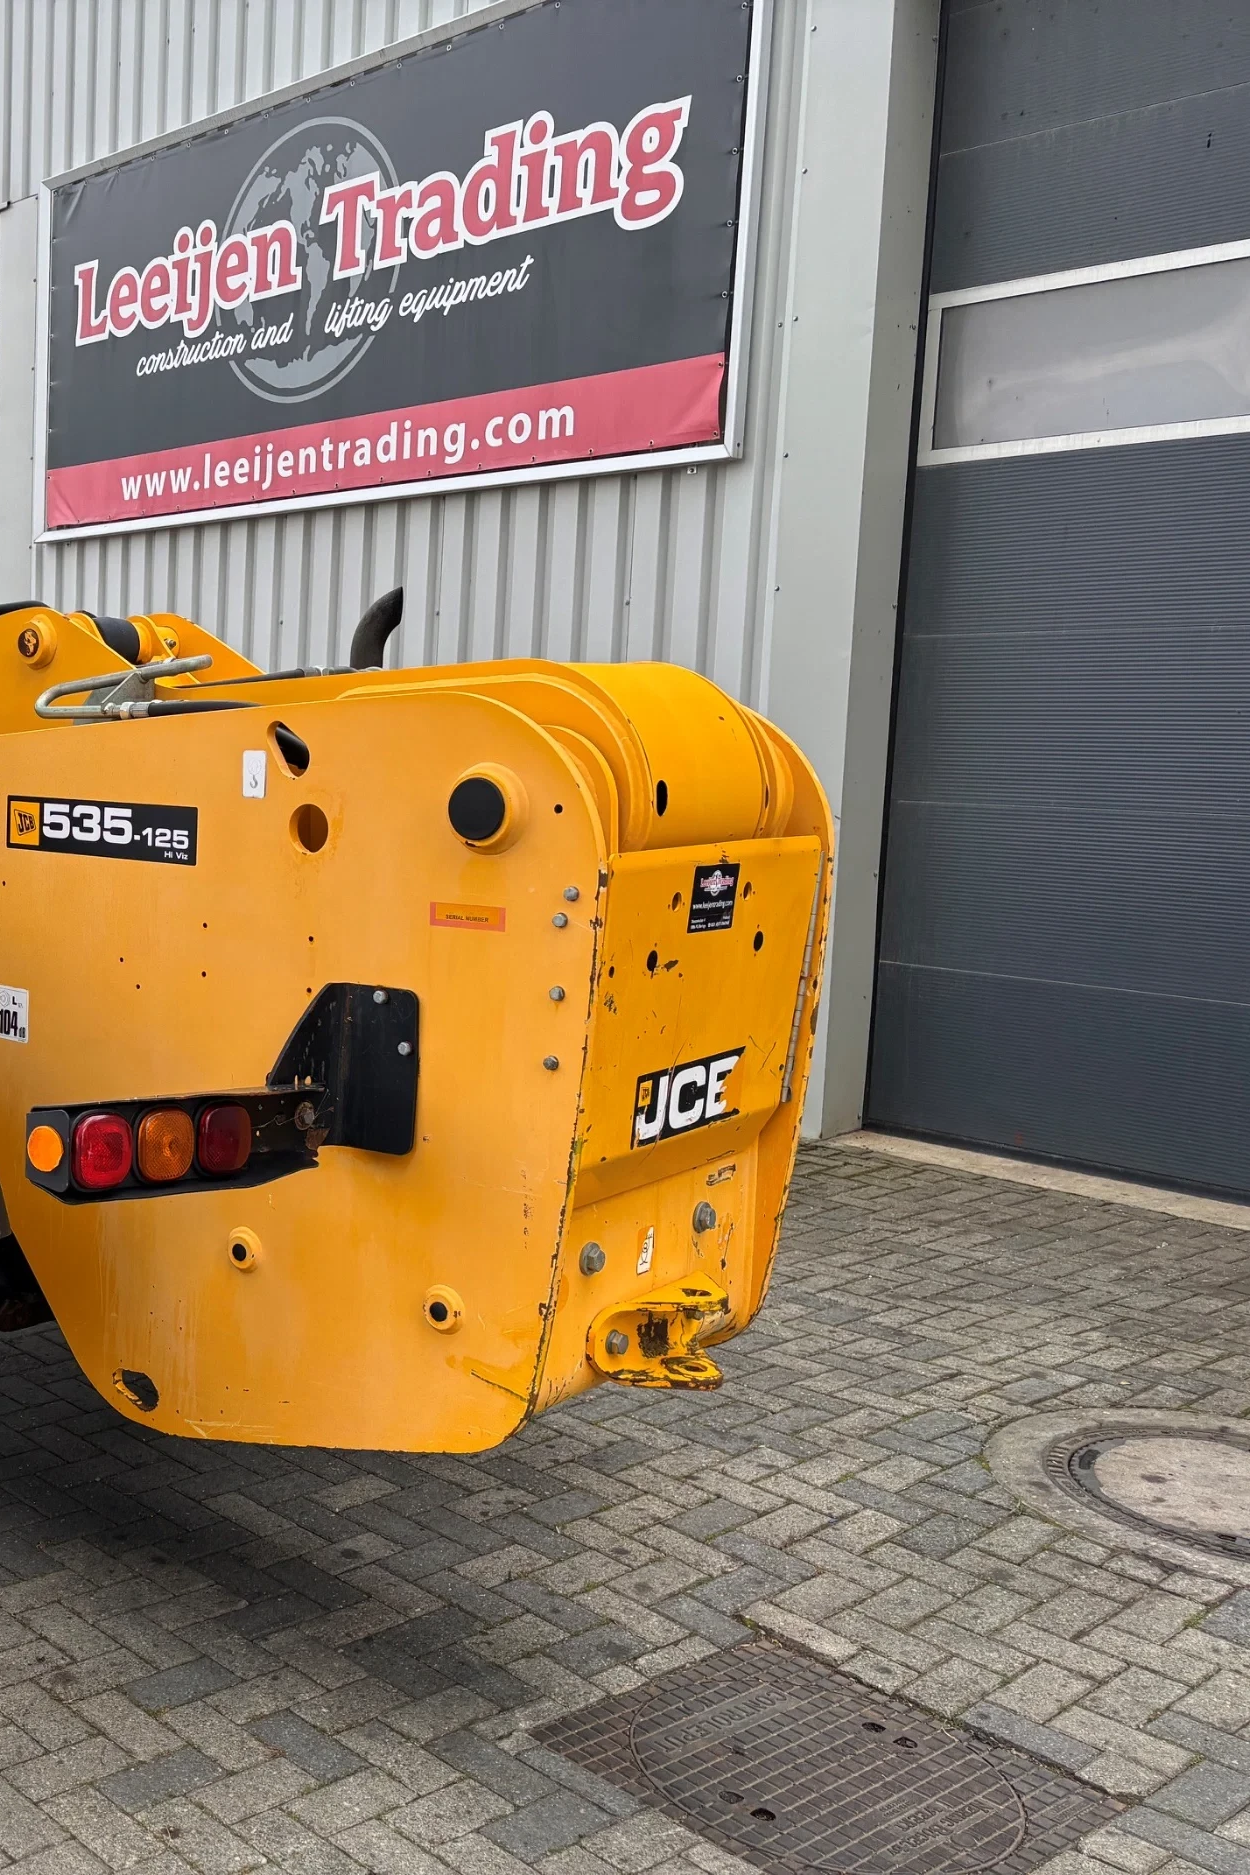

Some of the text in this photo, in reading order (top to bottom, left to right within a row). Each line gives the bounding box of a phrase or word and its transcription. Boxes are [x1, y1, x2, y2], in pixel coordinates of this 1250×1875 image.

[75, 95, 693, 346] Leeijen Trading
[324, 254, 536, 333] lifting equipment
[136, 313, 294, 377] construction and
[121, 402, 576, 501] www.leeijentrading.com
[17, 812, 36, 834] JCB
[164, 850, 189, 860] Hi Viz
[465, 915, 489, 923] NUMBER
[0, 1008, 19, 1037] 104
[654, 1690, 787, 1753] CONTROLEPUT
